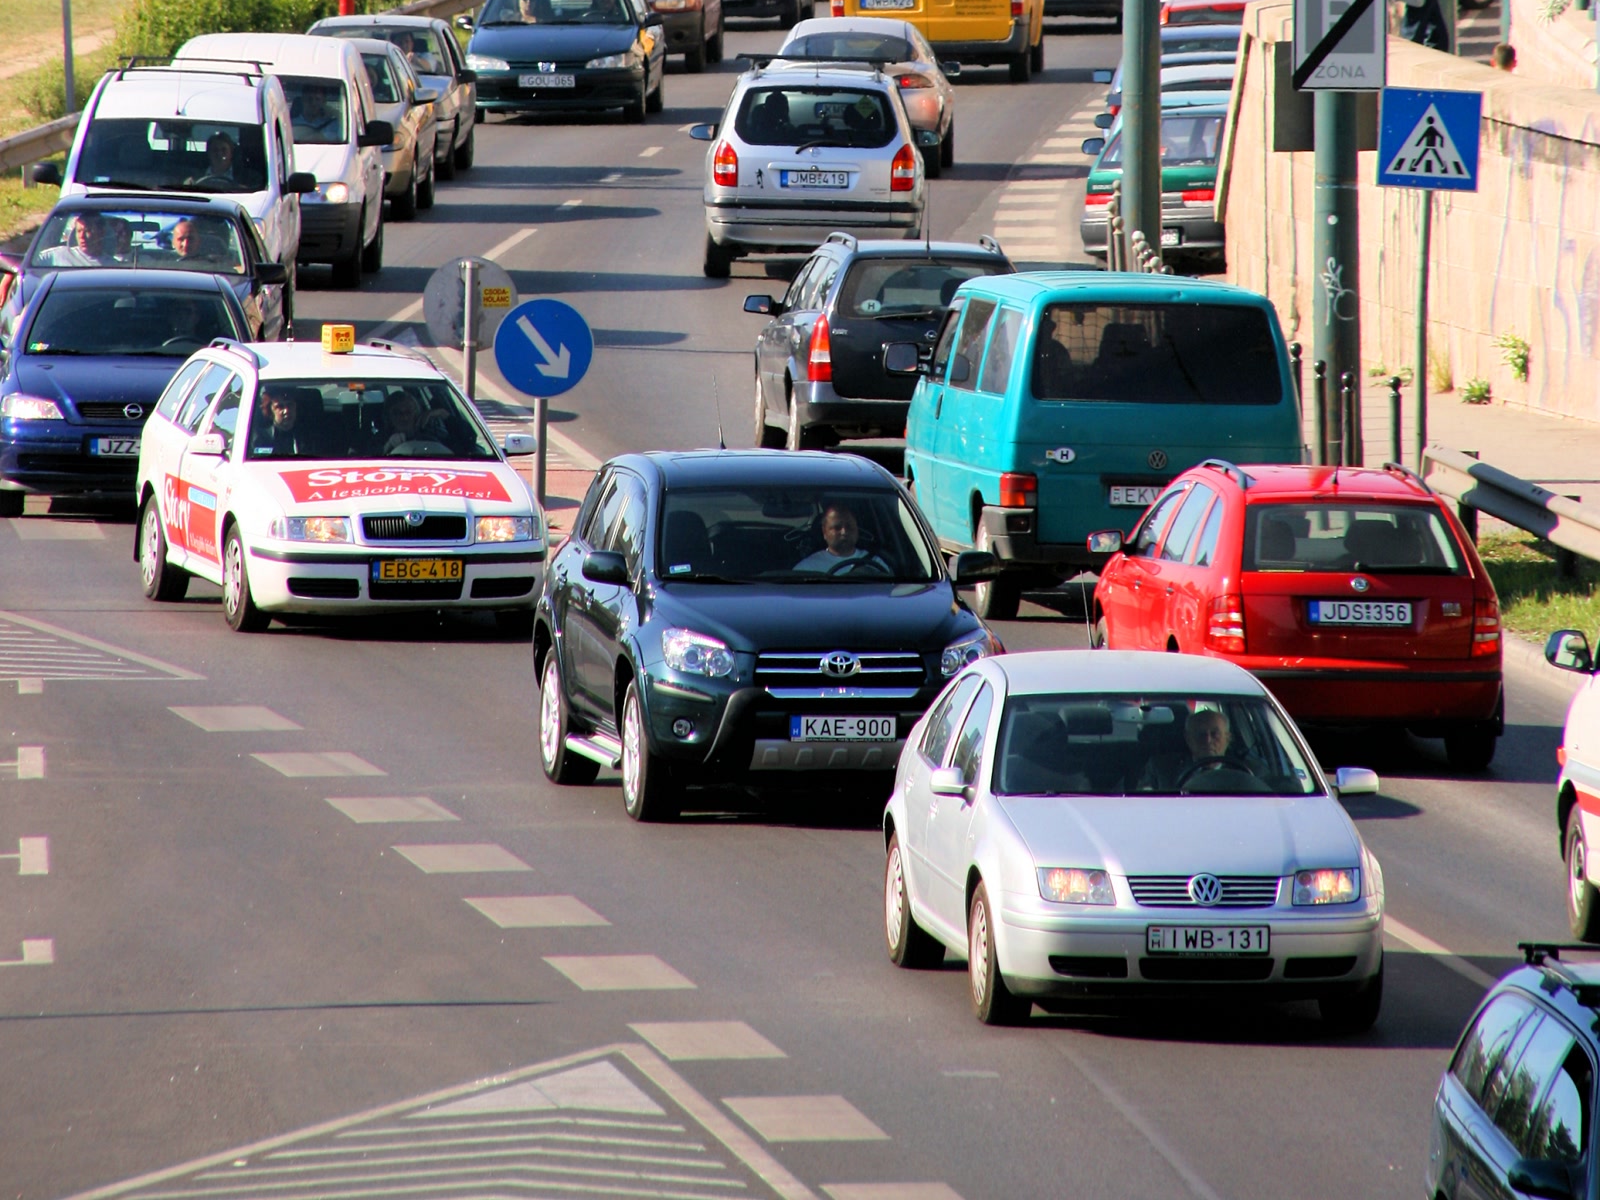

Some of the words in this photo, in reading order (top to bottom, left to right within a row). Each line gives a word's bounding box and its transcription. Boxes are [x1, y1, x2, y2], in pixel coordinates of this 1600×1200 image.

[1314, 62, 1366, 79] ZÓNA
[867, 302, 876, 310] H
[1060, 450, 1070, 460] H
[307, 470, 456, 487] Story
[308, 492, 323, 500] A
[331, 485, 411, 498] legjobb
[165, 478, 191, 548] Story
[383, 562, 460, 578] EBG-418
[805, 719, 892, 737] KAE-900
[1173, 929, 1263, 950] IWB-131
